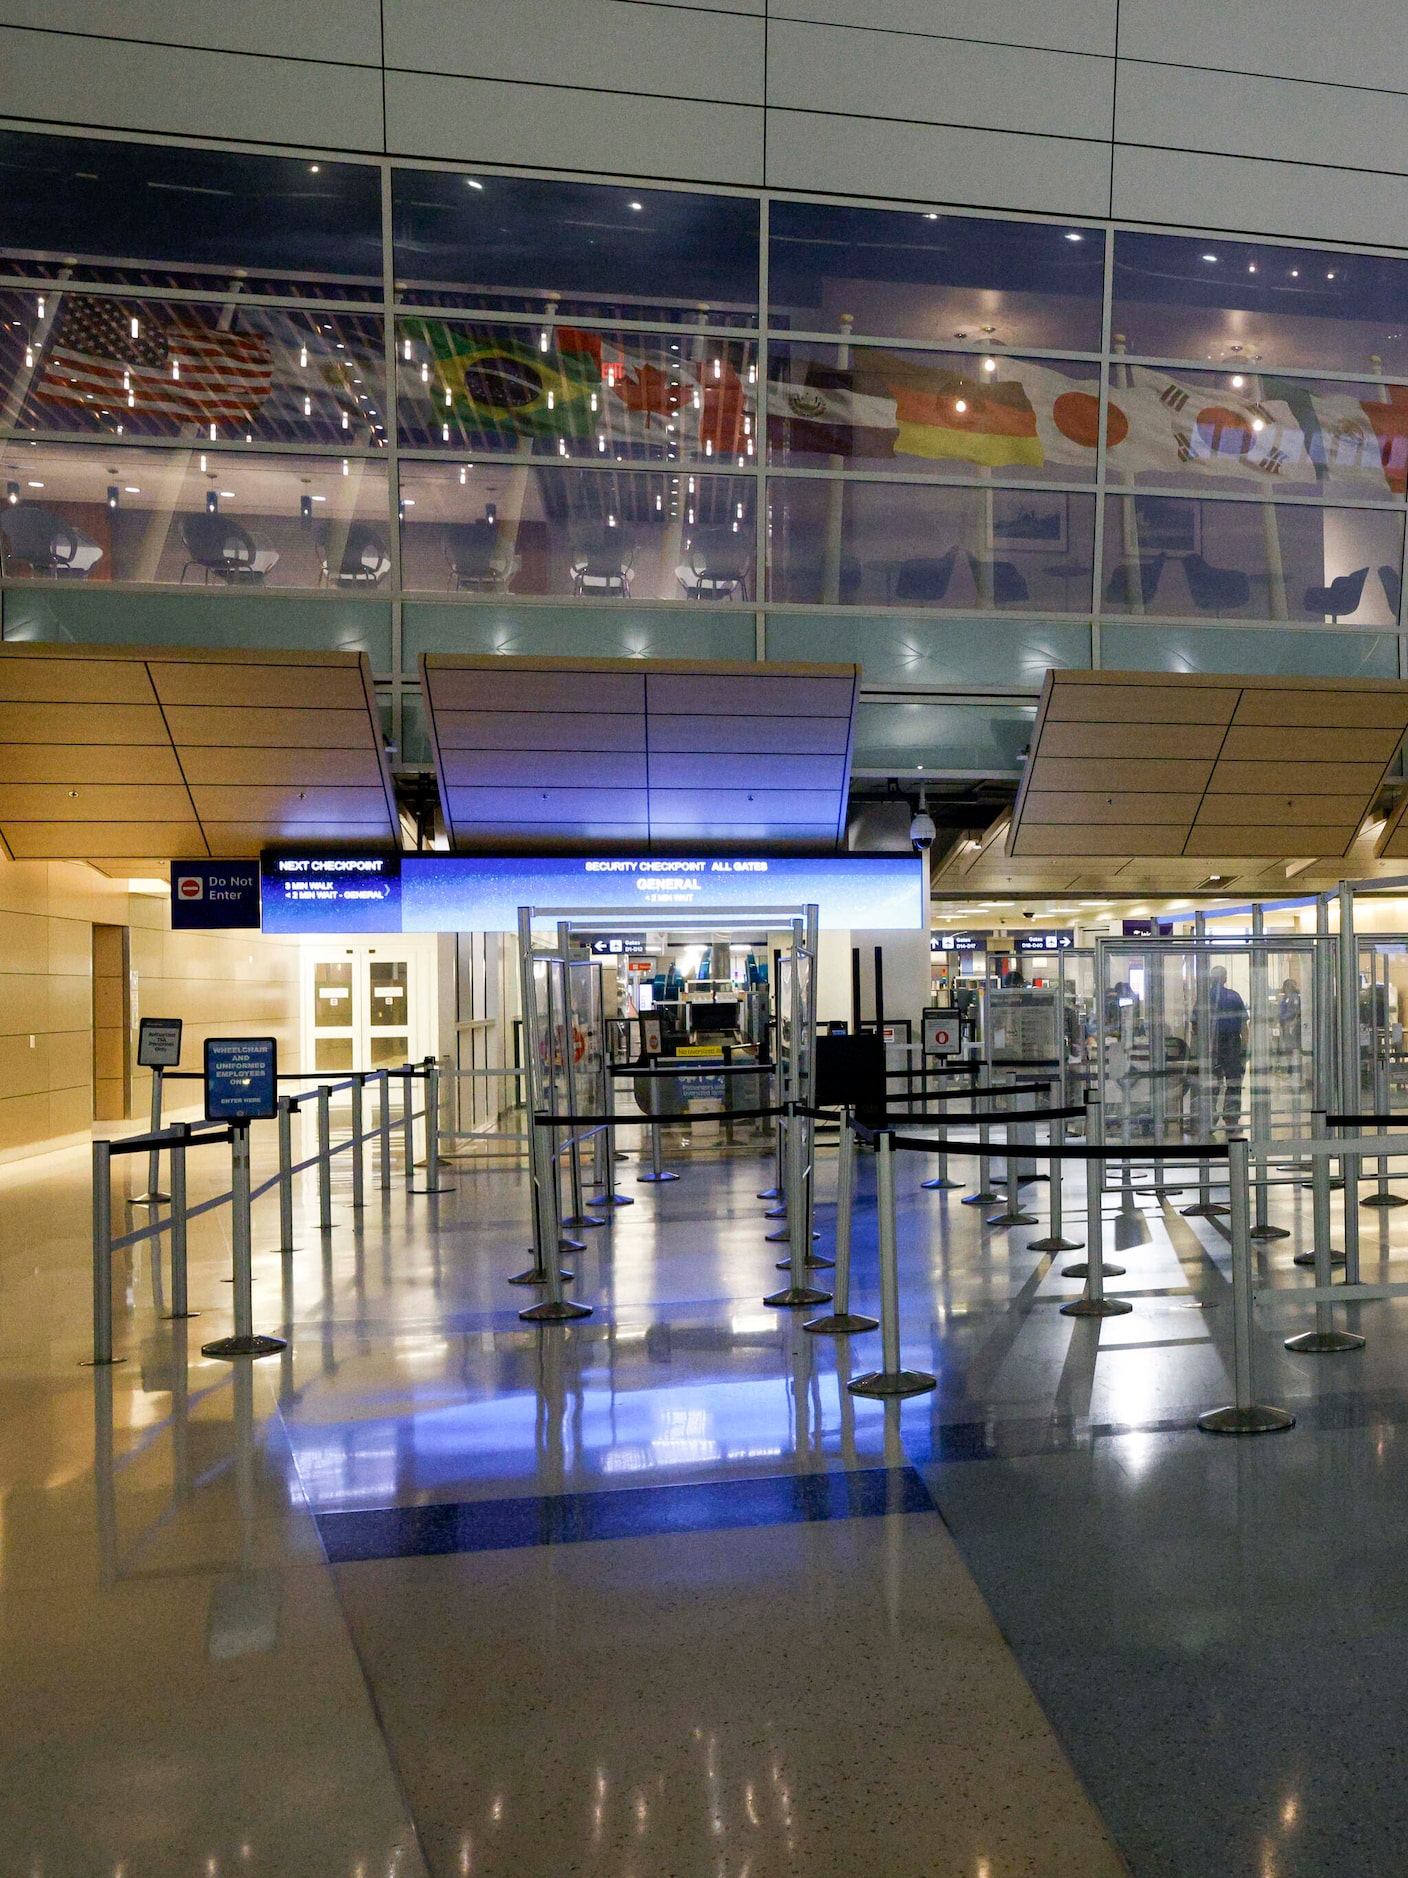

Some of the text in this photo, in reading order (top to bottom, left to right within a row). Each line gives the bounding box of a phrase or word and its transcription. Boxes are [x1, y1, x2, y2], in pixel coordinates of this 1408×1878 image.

[279, 860, 383, 871] NEXT CHECKPOINT
[585, 862, 768, 871] SECURITY CHECKPOINT ALL GATES
[209, 876, 252, 886] Do Not
[292, 882, 308, 890] MIN
[309, 882, 334, 890] WALK
[636, 878, 701, 890] GENERAL
[209, 890, 242, 900] Enter
[292, 891, 298, 899] 2
[316, 891, 338, 899] WAIT
[343, 891, 384, 899] GENERAL
